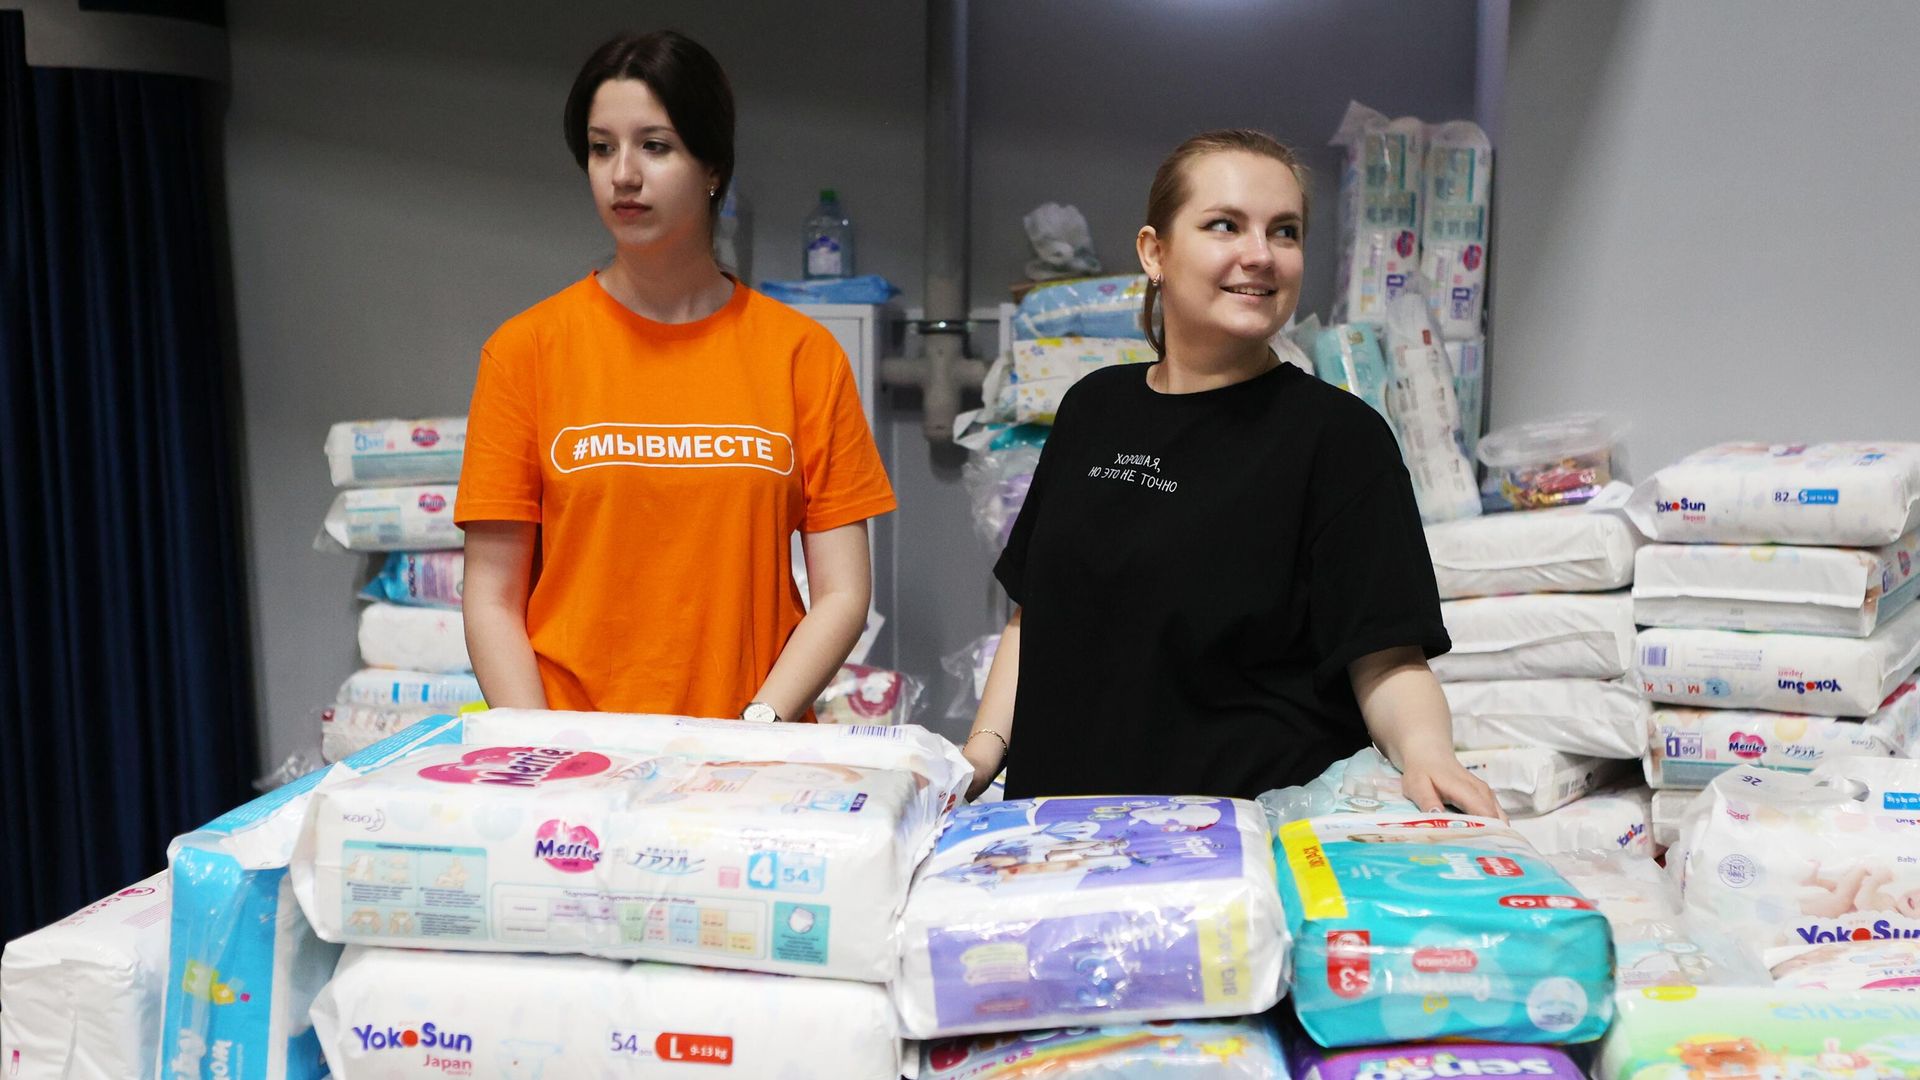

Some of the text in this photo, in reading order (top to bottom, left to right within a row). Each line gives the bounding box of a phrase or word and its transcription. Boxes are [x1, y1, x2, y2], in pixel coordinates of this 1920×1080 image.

[573, 434, 774, 461] #МЫВМЕСТЕ
[1114, 453, 1161, 473] ХОРОШАЯ,
[1088, 466, 1178, 492] НО ЭТО НЕ ТОЧНО
[1774, 491, 1790, 503] 82
[1682, 746, 1696, 756] 90
[479, 748, 575, 788] Merrie
[751, 854, 810, 887] 4 54
[353, 1022, 473, 1054] YokoSun
[611, 1032, 638, 1054] 54
[669, 1036, 683, 1059] L
[690, 1044, 713, 1058] 9-13
[715, 1047, 728, 1061] kg
[423, 1054, 472, 1071] Japan
